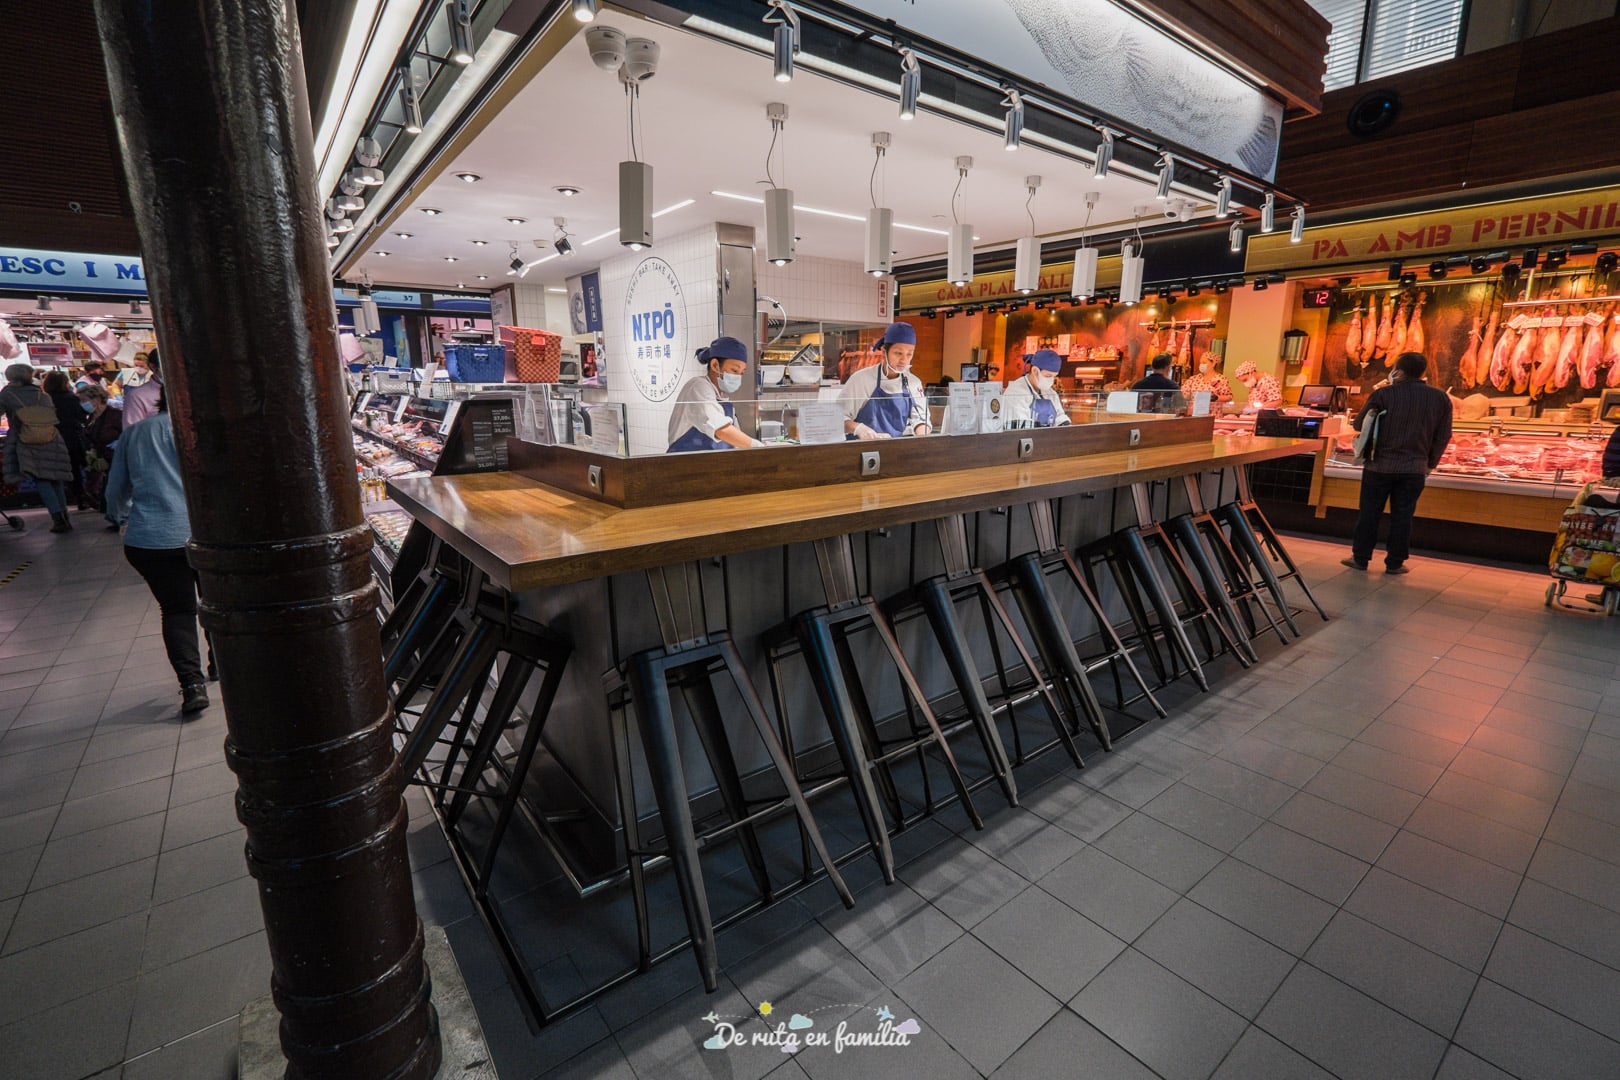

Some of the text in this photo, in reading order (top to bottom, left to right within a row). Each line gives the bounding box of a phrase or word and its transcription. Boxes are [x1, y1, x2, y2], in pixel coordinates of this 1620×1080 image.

[1312, 238, 1350, 261] PA
[1367, 224, 1453, 254] AMB
[0, 255, 146, 281] ESC I M
[937, 286, 974, 301] CASA
[1315, 288, 1329, 305] 12
